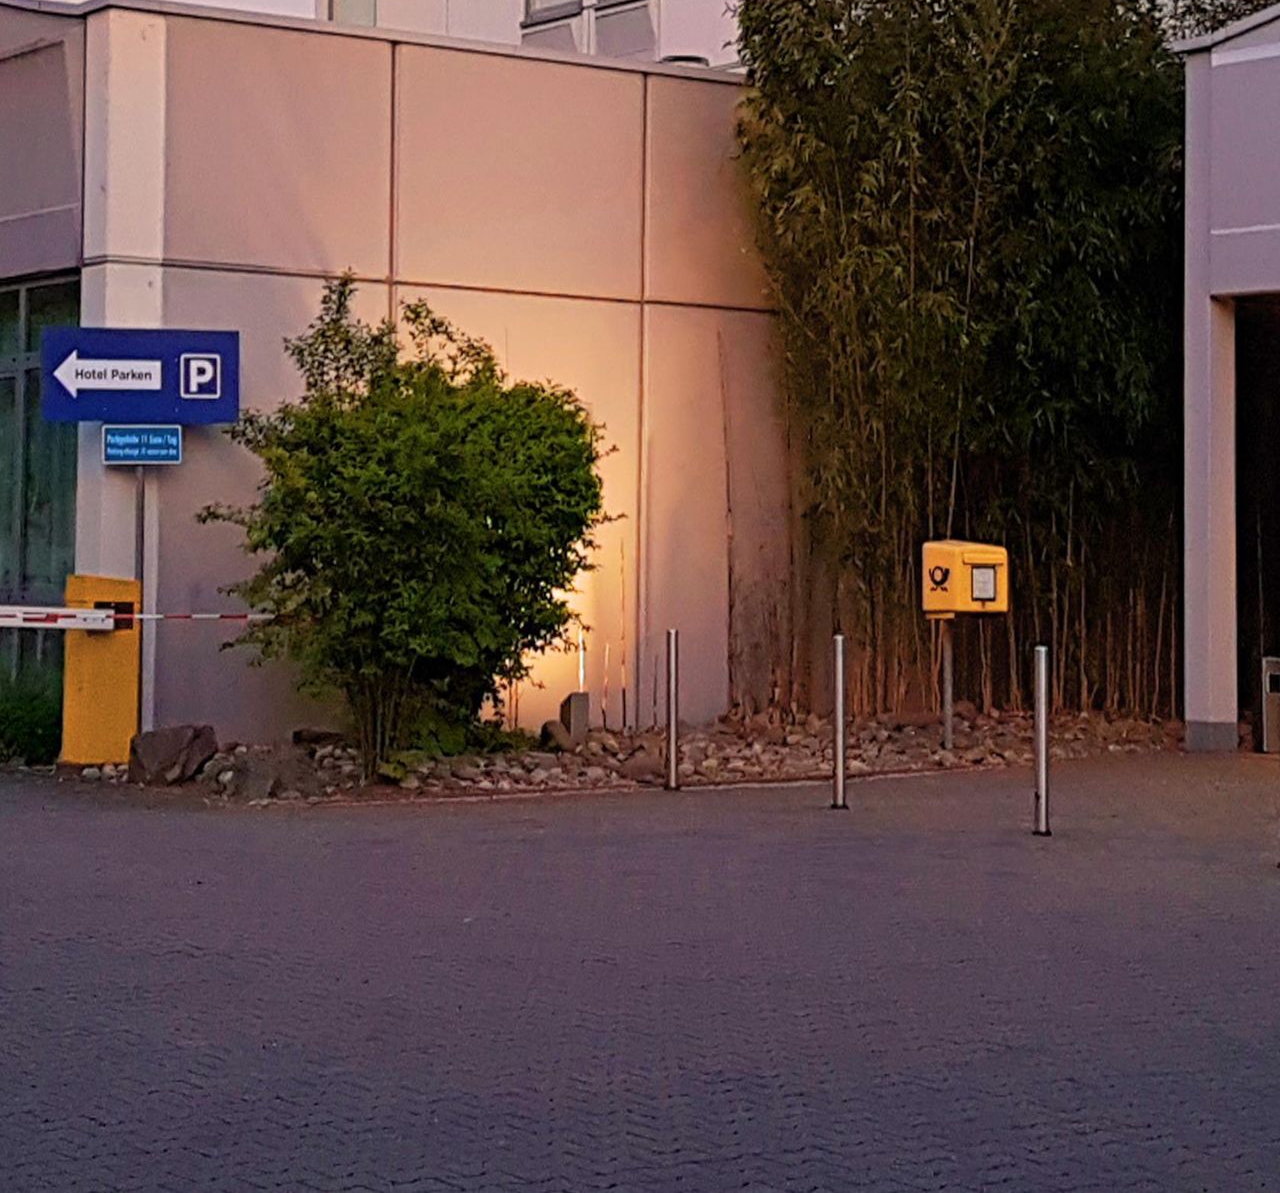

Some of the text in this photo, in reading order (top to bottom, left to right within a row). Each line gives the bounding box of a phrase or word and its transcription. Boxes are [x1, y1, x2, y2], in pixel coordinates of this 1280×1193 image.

[75, 368, 152, 381] Hotel Parken
[189, 359, 214, 393] P
